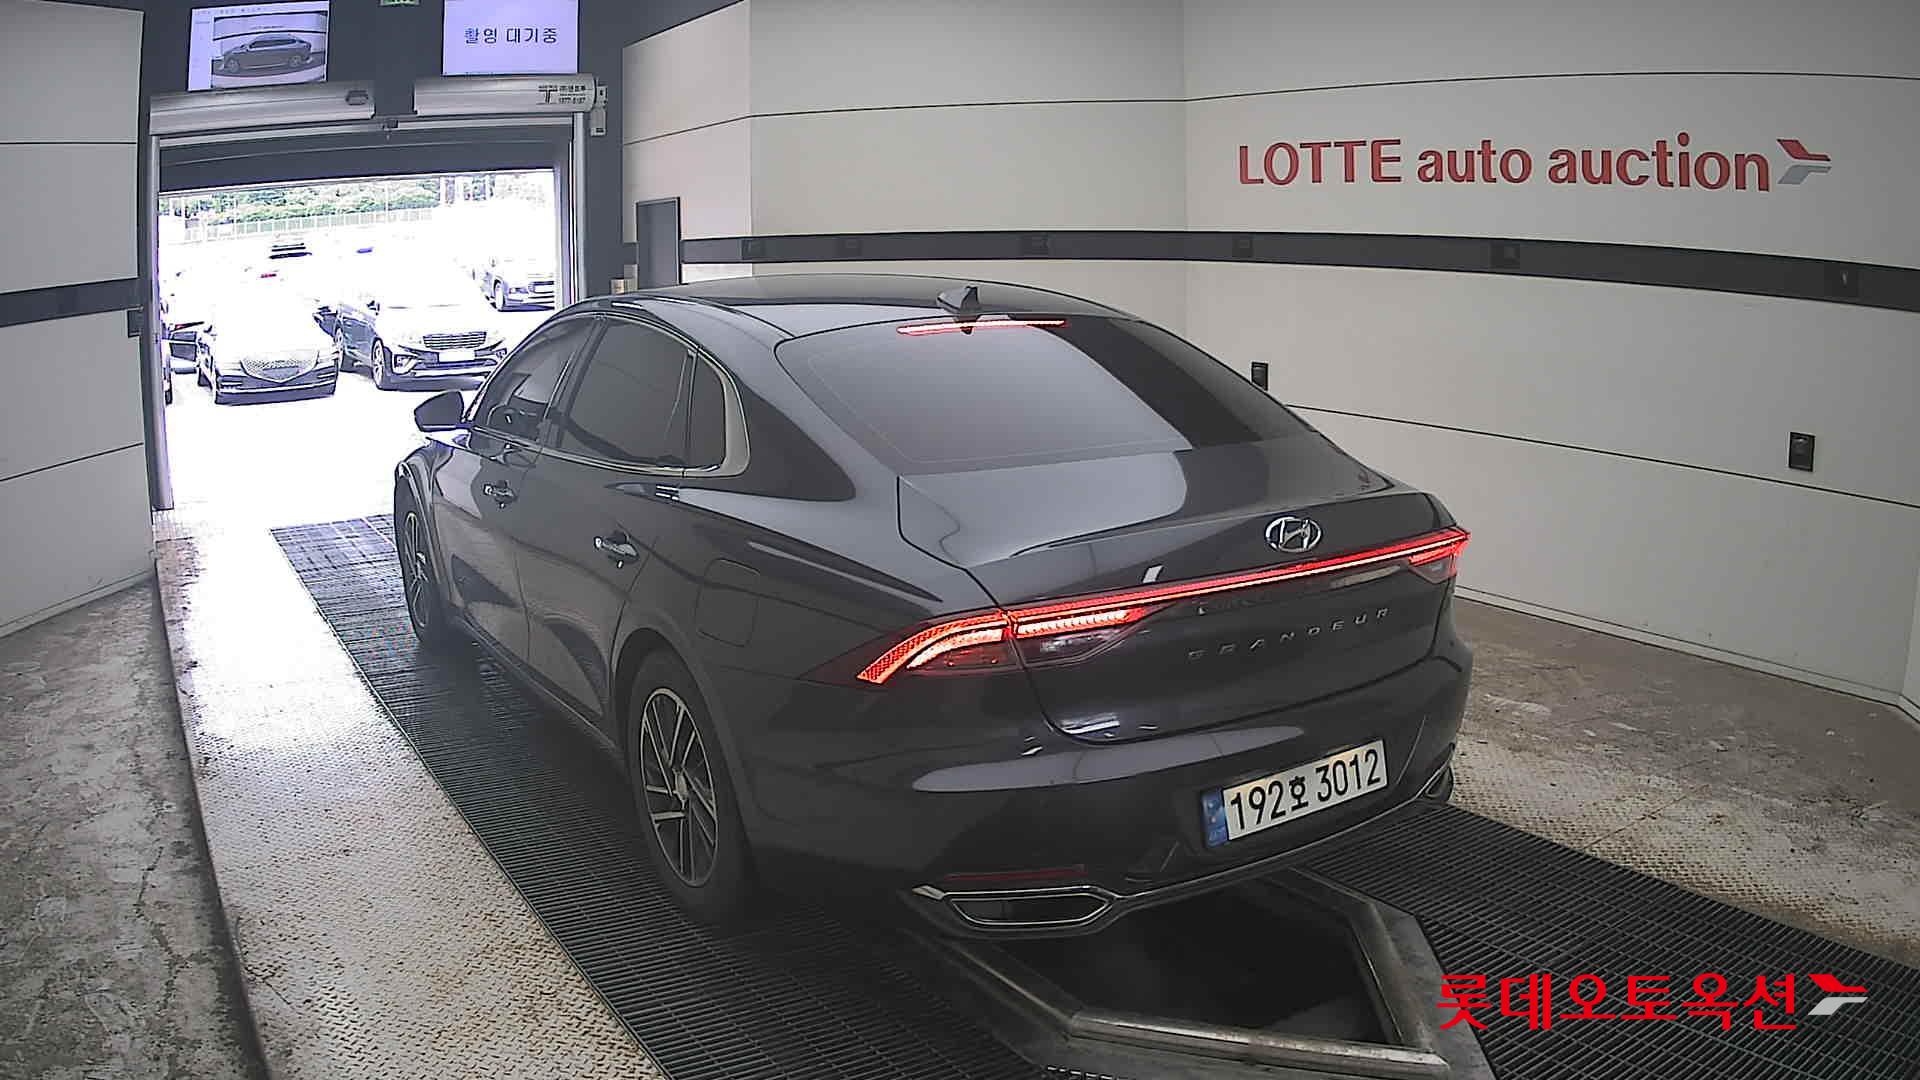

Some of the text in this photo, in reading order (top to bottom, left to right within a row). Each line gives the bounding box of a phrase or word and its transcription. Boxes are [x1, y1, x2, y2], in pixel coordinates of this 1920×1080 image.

[506, 27, 557, 44] 대기중
[1239, 132, 1770, 192] LOTTE auto auction
[1187, 607, 1390, 660] GRANDEUR
[1230, 748, 1381, 830] 192호 3012
